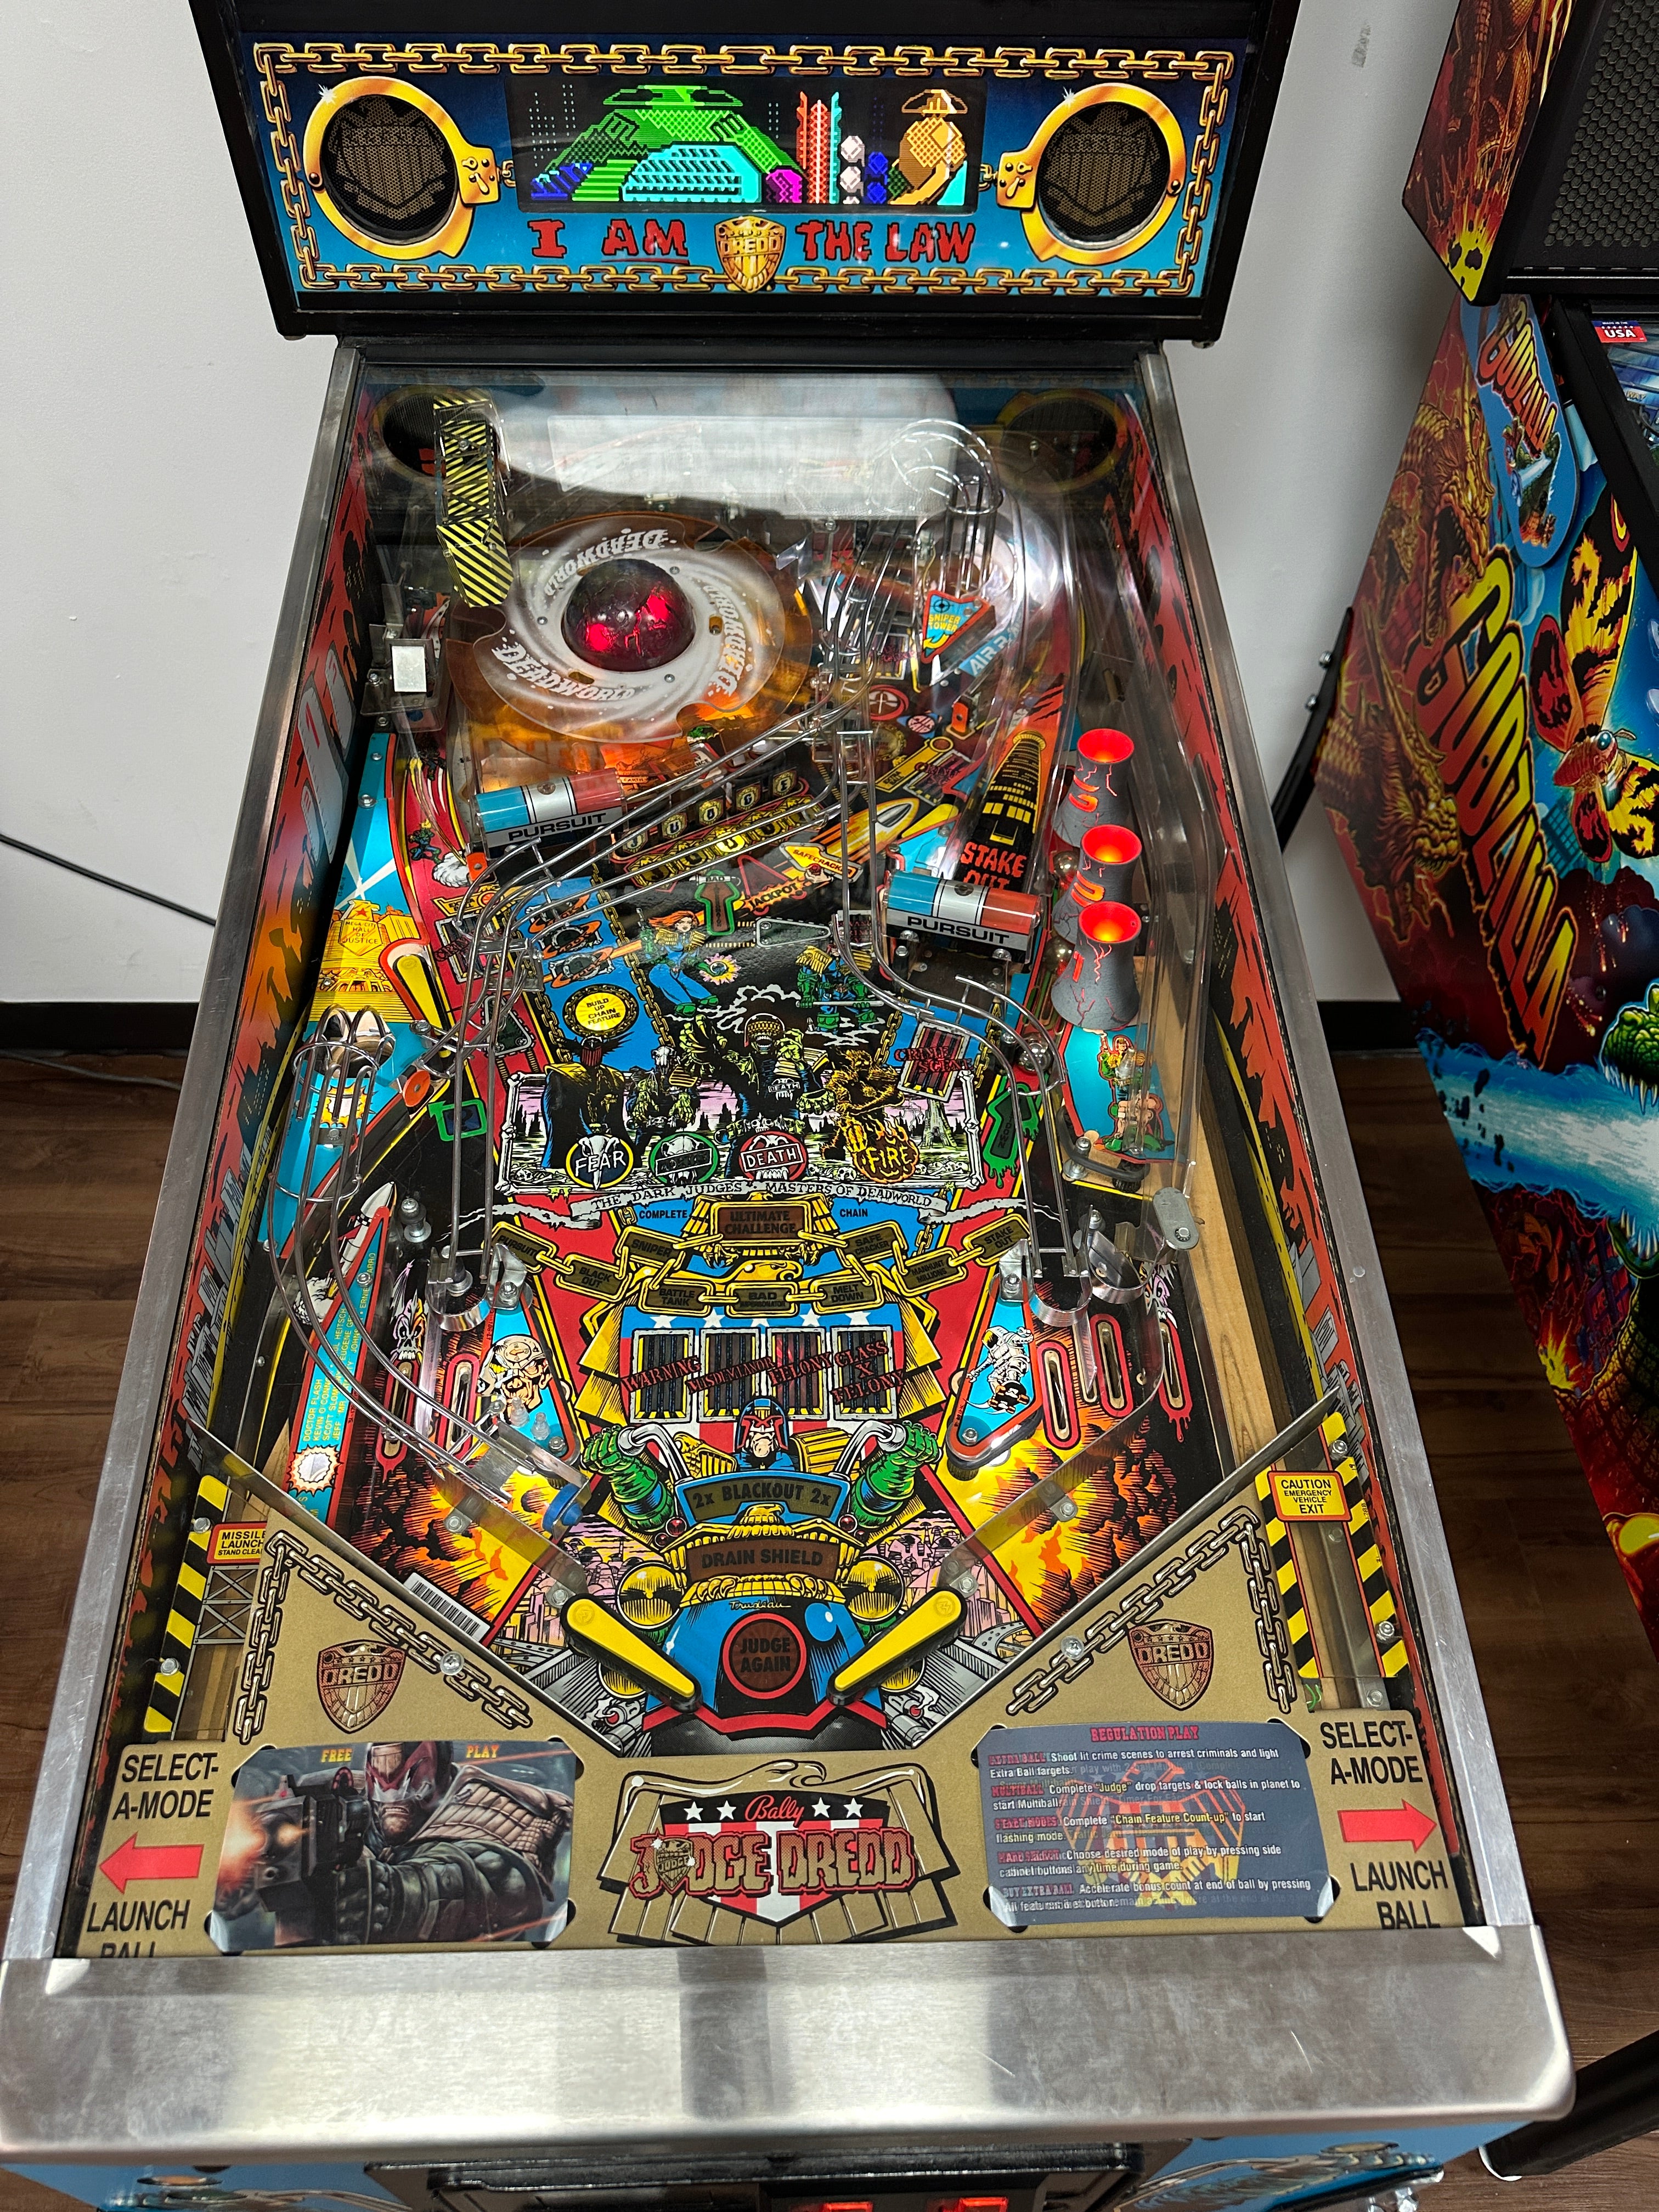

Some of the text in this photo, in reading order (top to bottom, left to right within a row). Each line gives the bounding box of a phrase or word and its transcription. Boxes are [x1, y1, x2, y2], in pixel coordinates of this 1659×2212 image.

[528, 219, 975, 263] I AM THE LAW
[718, 236, 783, 256] DREDD
[1604, 330, 1636, 338] USA
[928, 622, 958, 632] TOWER
[929, 614, 961, 624] SNIPER
[969, 646, 997, 676] AIR
[492, 641, 635, 701] DEADWORLD
[508, 812, 606, 841] PURSUIT
[960, 842, 1027, 878] STAKE
[748, 882, 799, 911] JACKPOT
[907, 916, 1010, 945] PURSUIT
[587, 998, 609, 1007] BUILD
[588, 1008, 617, 1019] CHAIN
[588, 1013, 621, 1025] FEATURE
[894, 1046, 952, 1062] CRIME
[917, 1058, 974, 1073] SCENE
[769, 1082, 799, 1092] DEATH
[575, 1149, 626, 1177] FEAR
[746, 1149, 797, 1167] DEATH
[868, 1144, 912, 1171] FIRE
[592, 1182, 932, 1211] THE DARK JUDGES MASTERS OF DEADWORLD
[639, 1209, 868, 1219] COMPLETE CHAIN
[730, 1211, 790, 1222] ULTIMATE
[725, 1223, 795, 1233] CHALLENGE
[984, 1226, 1014, 1244] STAKE
[499, 1235, 538, 1259] PURSUIT
[631, 1238, 672, 1257] SNIPER
[855, 1233, 882, 1249] SAFE
[994, 1237, 1013, 1249] OUT
[579, 1267, 612, 1283] BLACK
[911, 1260, 944, 1276] MANHUNT
[917, 1268, 948, 1282] MILLIONS
[582, 1276, 602, 1288] OUT
[833, 1284, 858, 1294] MELT
[659, 1288, 695, 1299] BATTLE
[662, 1296, 691, 1307] TANK
[831, 1291, 865, 1303] DOWN
[834, 1340, 889, 1367] CLASS
[620, 1355, 701, 1392] WARNING
[768, 1351, 832, 1386] FELONY
[855, 1362, 872, 1378] X
[831, 1369, 905, 1404] FELONY
[303, 1379, 323, 1441] DOCTOR FLASH
[312, 1416, 324, 1441] KEVIN
[322, 1414, 334, 1441] SCOTT
[1280, 1479, 1331, 1490] CAUTION
[692, 1482, 832, 1509] 2x BLACKOUT 2x
[1284, 1489, 1333, 1498] EMERGENCY
[1299, 1503, 1324, 1515] EXIT
[701, 1548, 823, 1568] DRAIN SHIELD
[729, 1600, 792, 1610] Trudeau
[740, 1638, 790, 1654] JUDGE
[1134, 1641, 1207, 1663] DREDD
[321, 1659, 399, 1685] DREDD
[741, 1656, 791, 1673] AGAIN
[1090, 1725, 1199, 1742] REGULATION PLAY
[1321, 1721, 1413, 1750] SELECT-
[320, 1744, 500, 1764] FREE PLAY
[1051, 1748, 1279, 1763] Shoot lit crime scenes to arrest criminals and light
[121, 1752, 219, 1782] SELECT-
[990, 1768, 1014, 1779] Extra
[1017, 1767, 1035, 1778] Ball
[1037, 1766, 1073, 1778] targets.
[1330, 1756, 1423, 1787] A-MODE
[1049, 1783, 1093, 1795] Complete
[1135, 1781, 1156, 1792] drop
[1159, 1780, 1191, 1792] targets
[1194, 1780, 1201, 1790] &
[1204, 1780, 1223, 1790] lock
[1226, 1780, 1248, 1790] balls
[1250, 1780, 1259, 1789] in
[1261, 1780, 1289, 1791] planet
[1291, 1780, 1300, 1788] to
[112, 1789, 212, 1820] A-MODE
[744, 1794, 804, 1827] Bally
[992, 1801, 1015, 1810] start
[1018, 1798, 1062, 1809] Multiball.
[1063, 1812, 1266, 1827] Complete Feature to start
[996, 1831, 1066, 1844] flashing mode.
[777, 1827, 918, 1895] DREDD
[1066, 1845, 1282, 1860] Choose desired mode of play by pressing side
[1120, 1861, 1150, 1872] during
[1153, 1860, 1183, 1871] game.
[1351, 1861, 1449, 1893] LAUNCH
[1079, 1878, 1311, 1894] Accelerate bonus count at end of ball by pressing
[86, 1898, 191, 1934] LAUNCH
[1376, 1900, 1441, 1929] BALL
